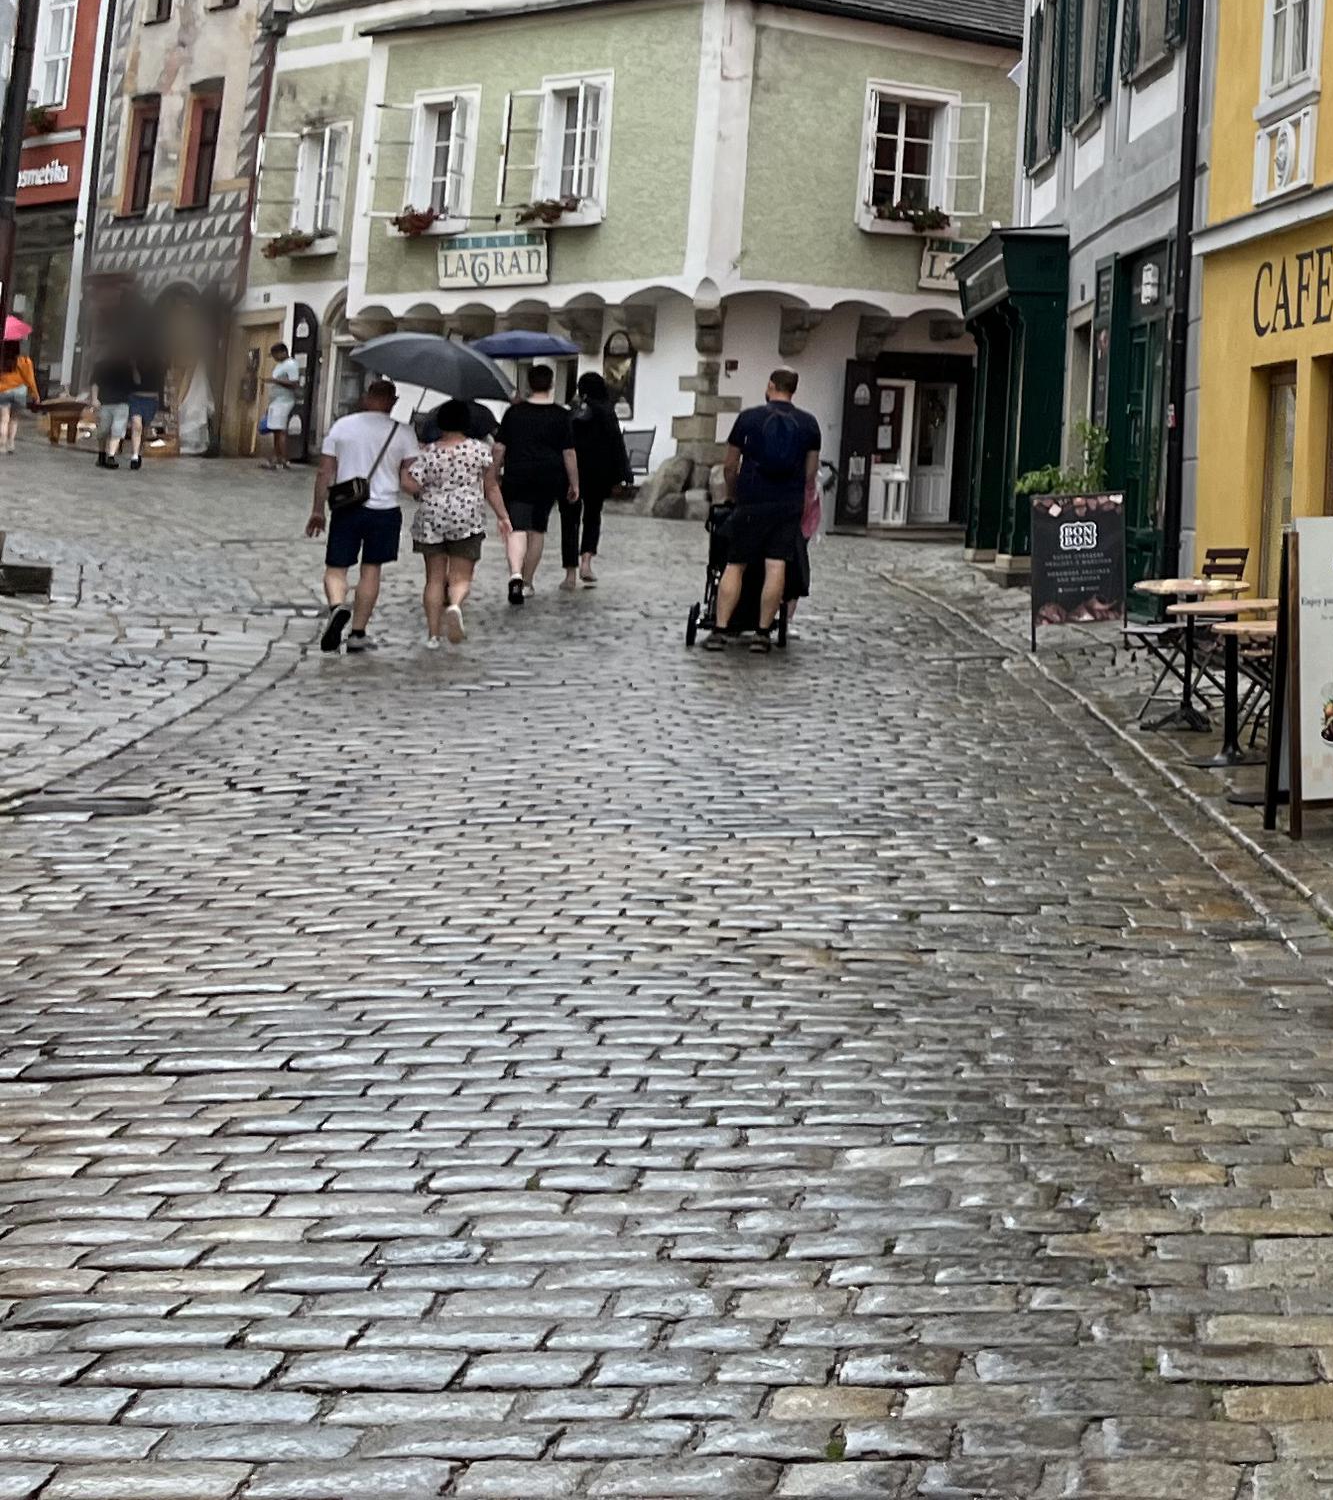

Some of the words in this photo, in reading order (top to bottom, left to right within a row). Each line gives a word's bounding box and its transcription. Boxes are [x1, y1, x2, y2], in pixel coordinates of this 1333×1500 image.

[1253, 245, 1333, 338] CAFE
[1064, 526, 1094, 537] BON
[1064, 536, 1094, 548] BON
